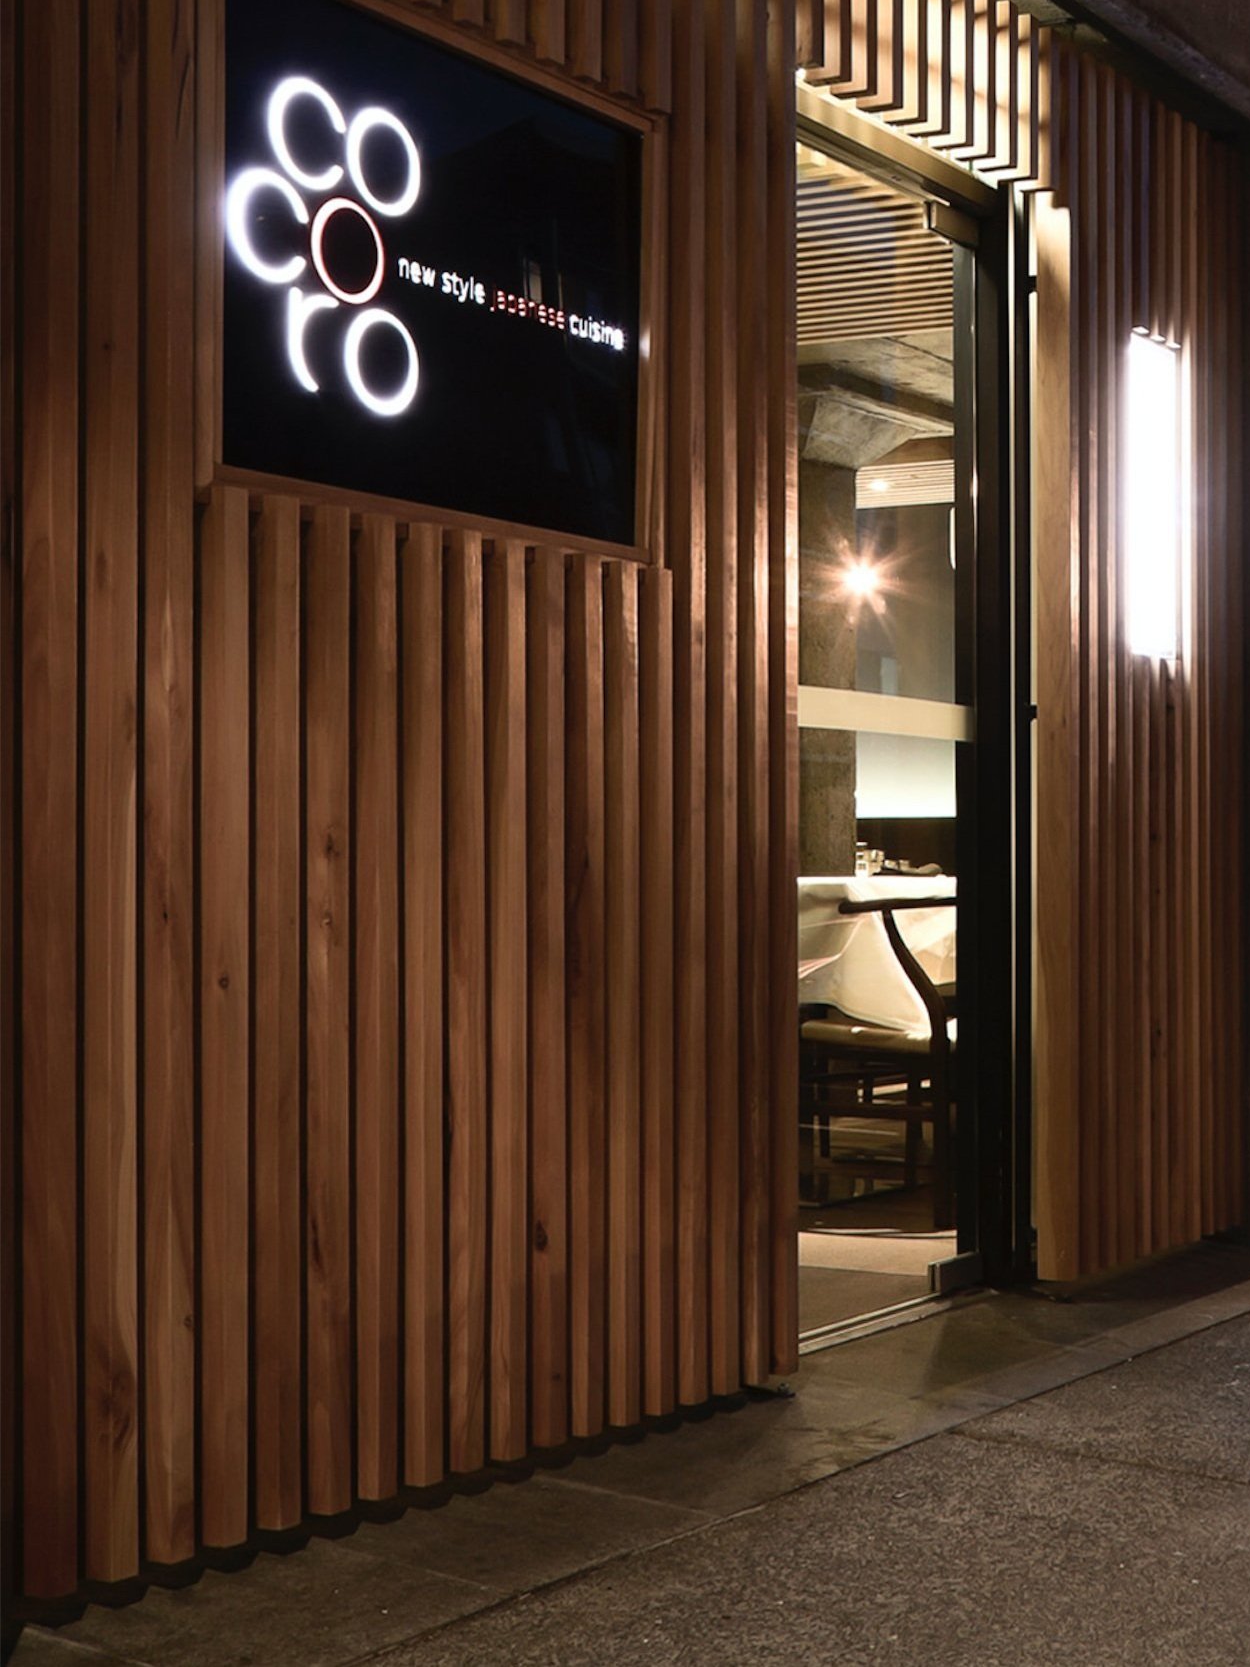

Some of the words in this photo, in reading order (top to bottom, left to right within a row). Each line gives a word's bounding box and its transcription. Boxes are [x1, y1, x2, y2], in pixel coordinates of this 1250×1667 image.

[397, 256, 436, 288] new
[441, 271, 486, 305] style
[490, 284, 567, 331] japanese
[568, 313, 626, 352] cuisine
